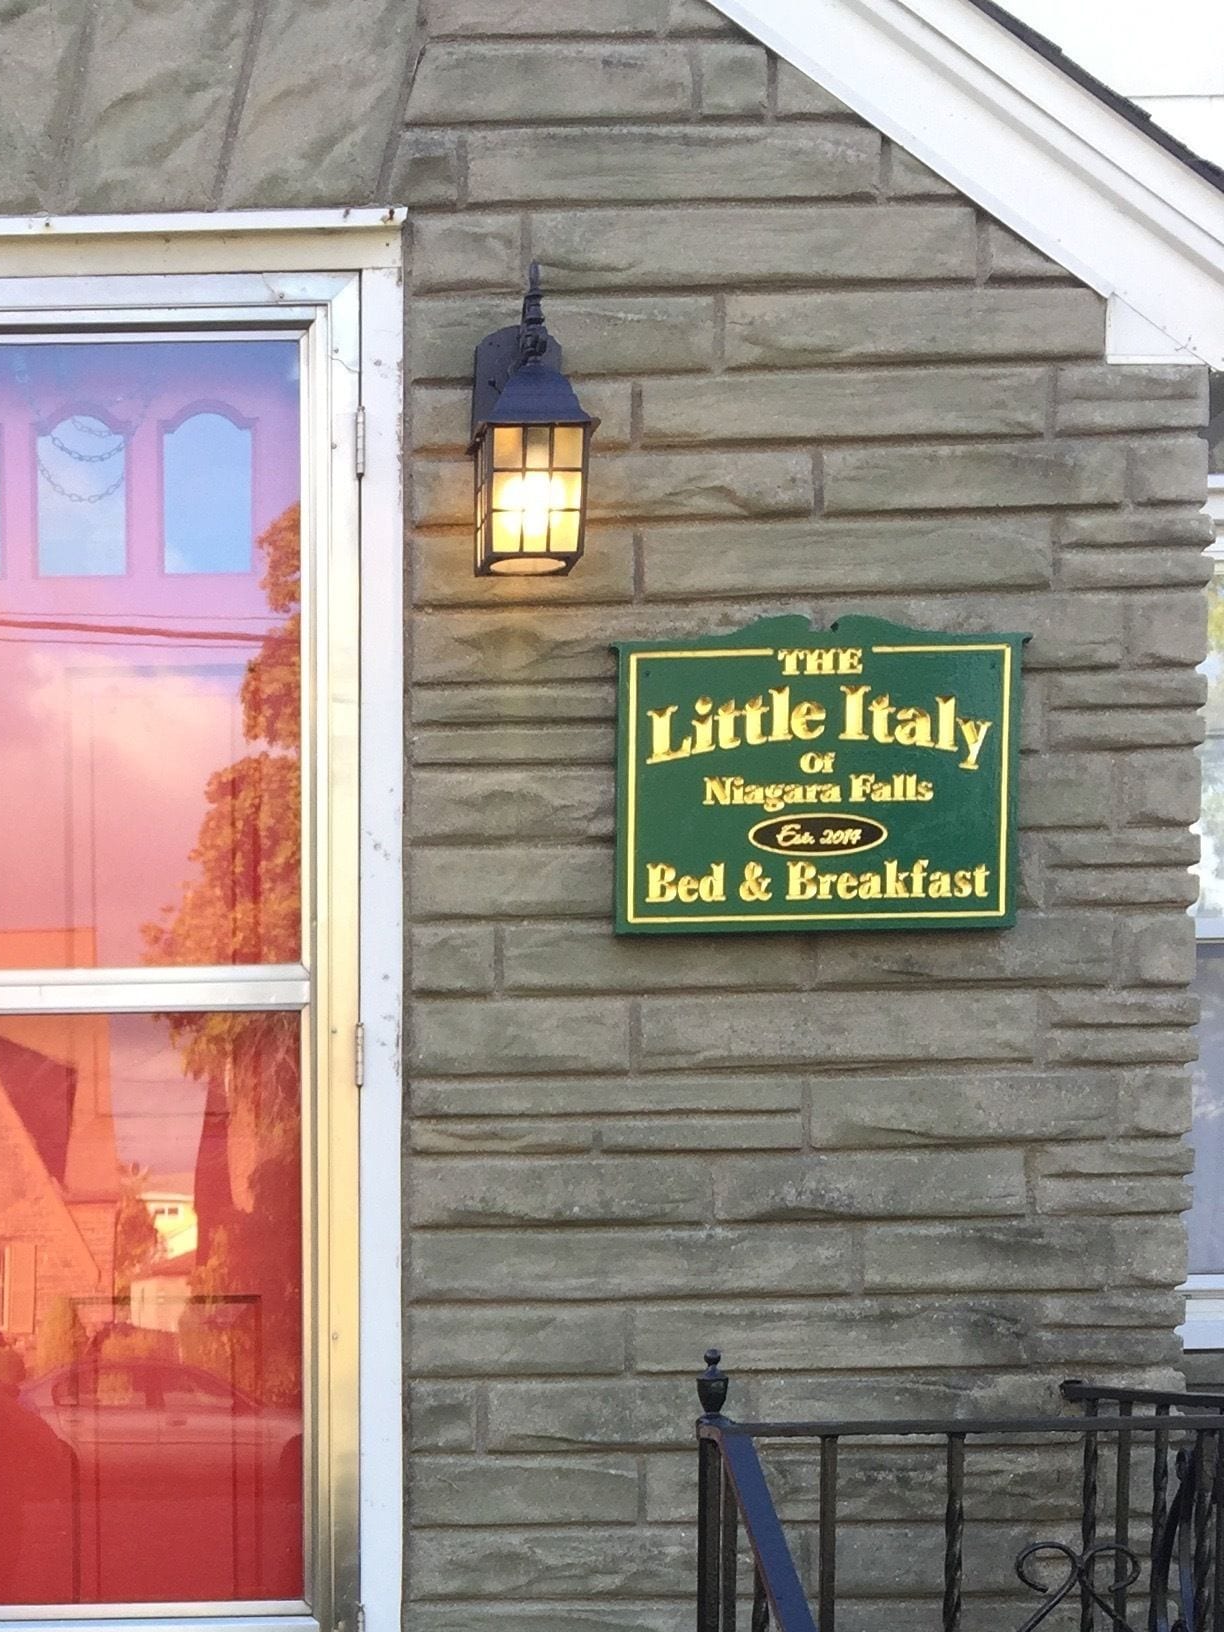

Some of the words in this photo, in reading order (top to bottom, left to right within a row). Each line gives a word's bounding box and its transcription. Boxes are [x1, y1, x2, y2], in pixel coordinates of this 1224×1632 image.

[777, 647, 863, 676] THE
[646, 685, 826, 764] Little
[839, 684, 992, 770] Italy
[702, 775, 841, 812] Niagara
[849, 774, 934, 803] Falls
[819, 828, 863, 845] 2014
[645, 862, 726, 904] Bed
[739, 861, 773, 902] &
[785, 858, 990, 901] Breakfast
